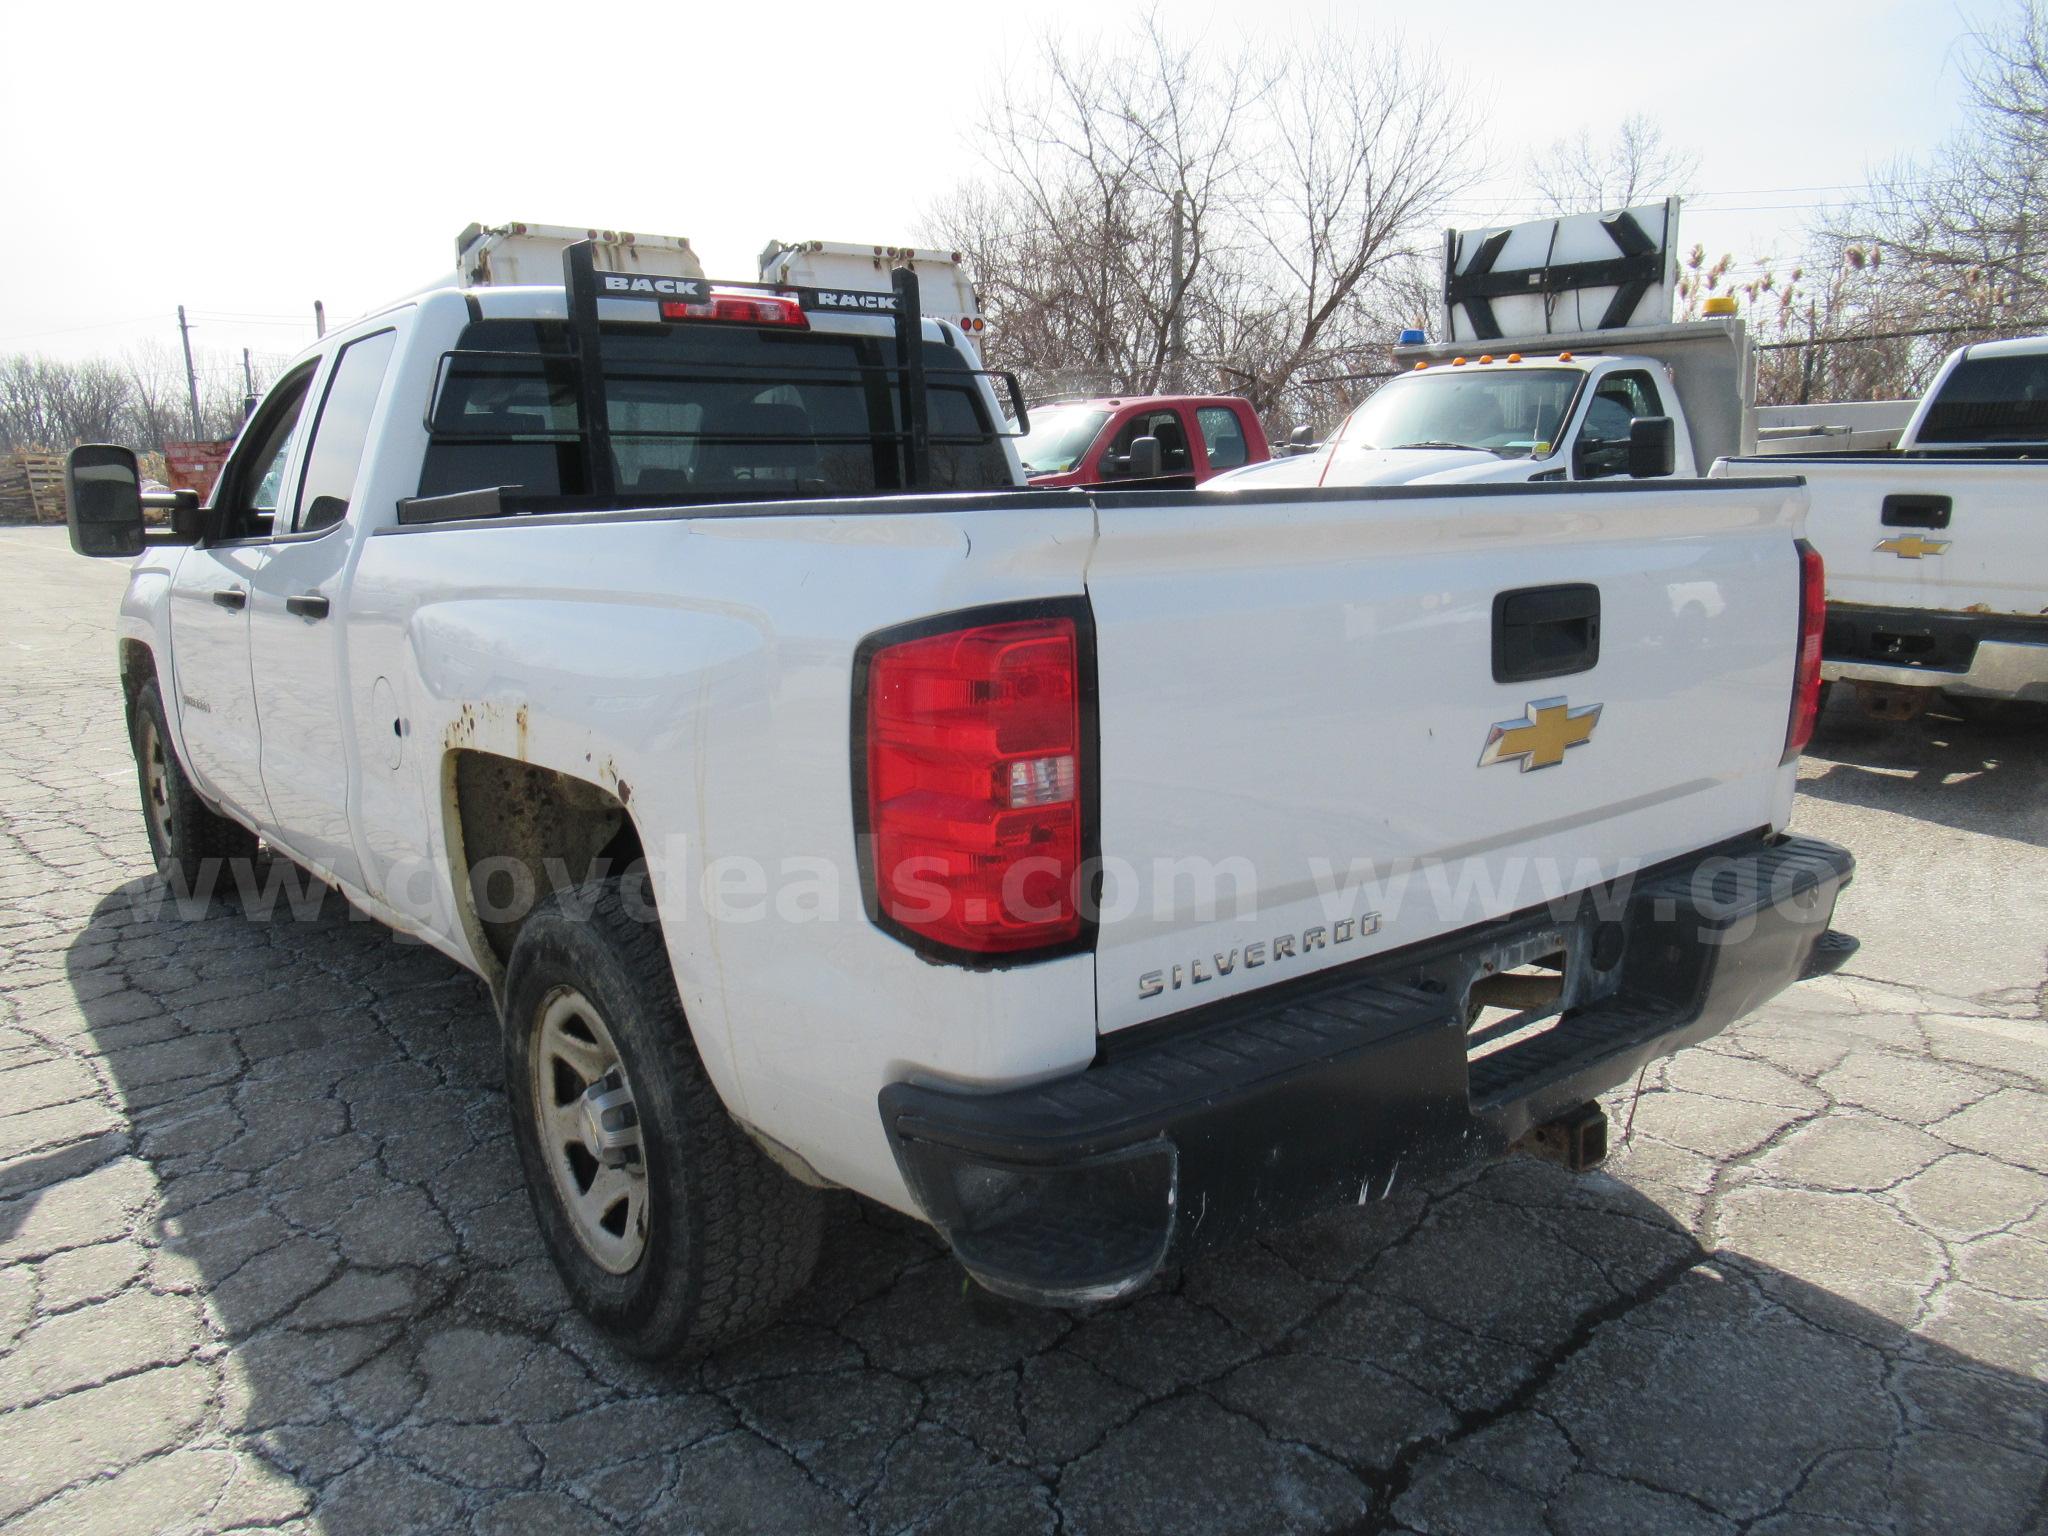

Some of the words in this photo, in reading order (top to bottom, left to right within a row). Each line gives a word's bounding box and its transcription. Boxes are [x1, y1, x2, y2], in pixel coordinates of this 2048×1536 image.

[605, 276, 698, 295] BACK
[818, 292, 899, 309] RACK
[1138, 910, 1384, 1000] SILVERADO
